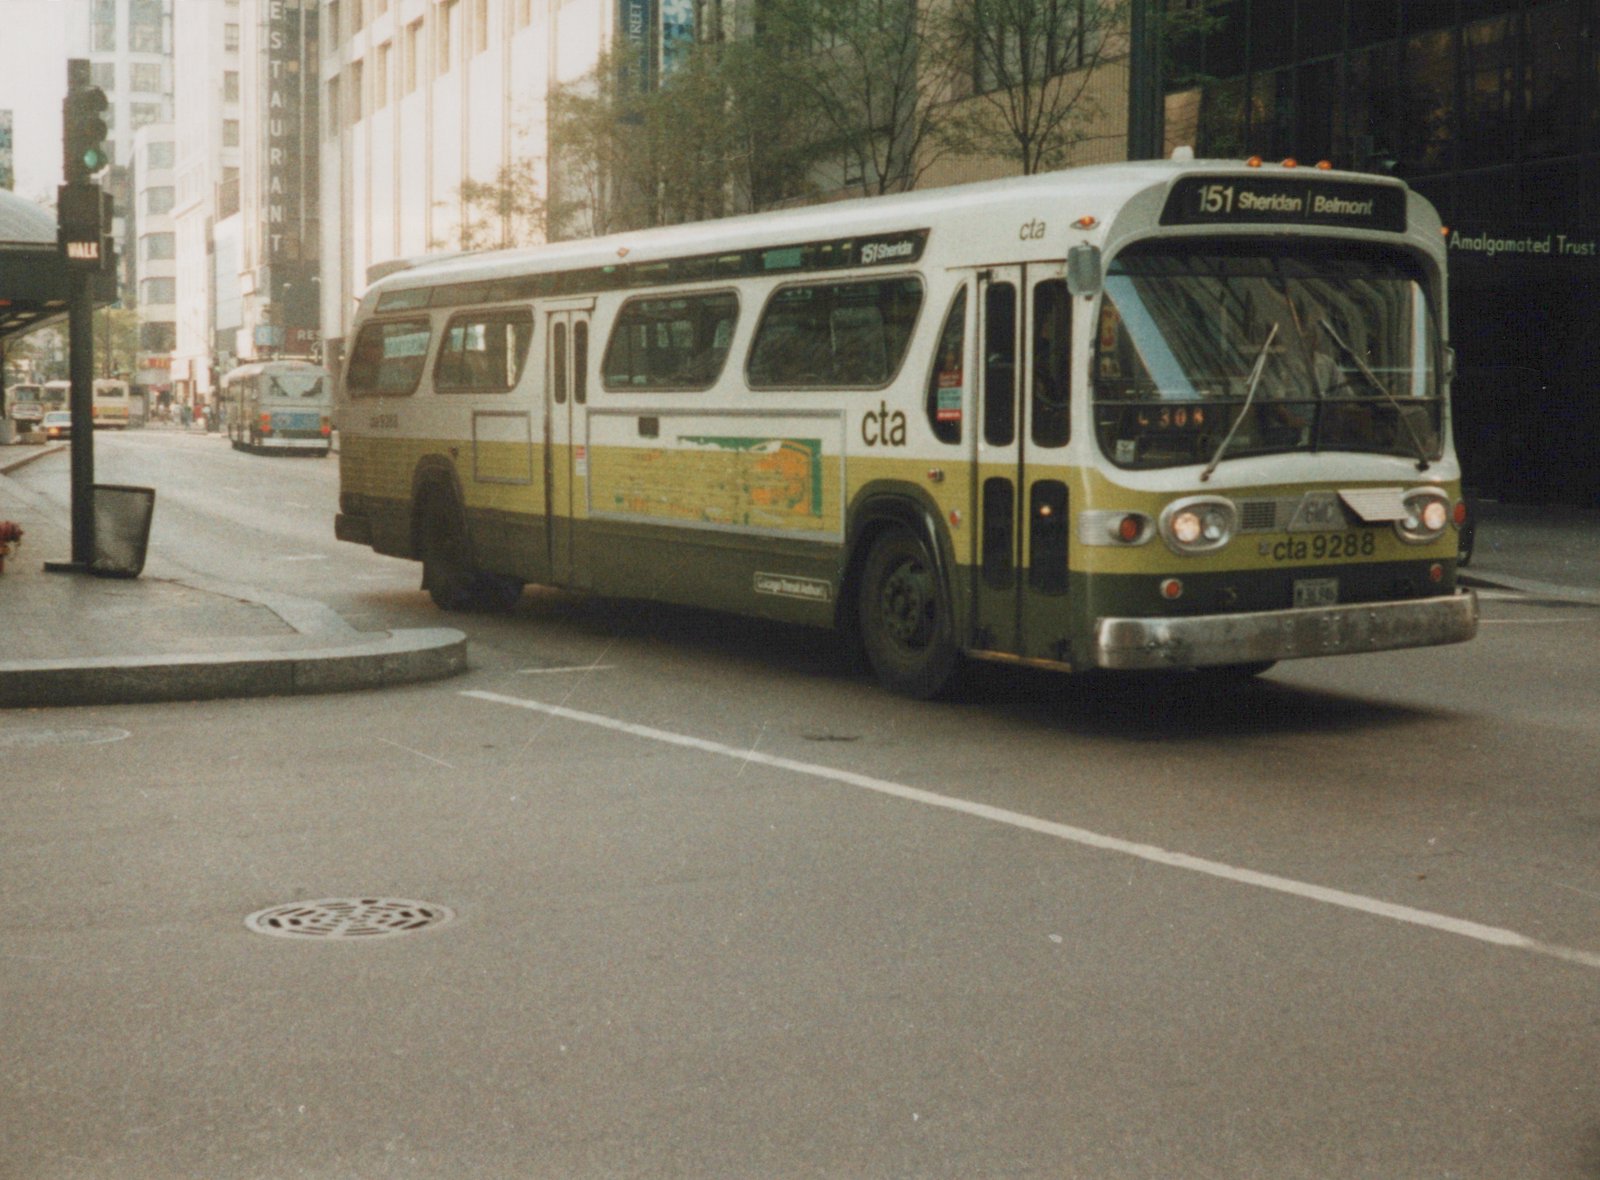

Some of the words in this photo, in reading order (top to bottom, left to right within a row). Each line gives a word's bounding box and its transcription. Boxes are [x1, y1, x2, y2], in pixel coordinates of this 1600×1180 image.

[1198, 185, 1234, 213] 151
[1238, 192, 1301, 212] Sheridan
[1314, 196, 1373, 215] Belmont
[1019, 218, 1046, 241] cta
[1450, 230, 1550, 256] Amalgamated
[1557, 234, 1596, 255] Trust
[67, 241, 99, 258] WALK
[861, 400, 907, 447] cta
[1273, 536, 1307, 560] cta
[1312, 532, 1375, 559] 9288
